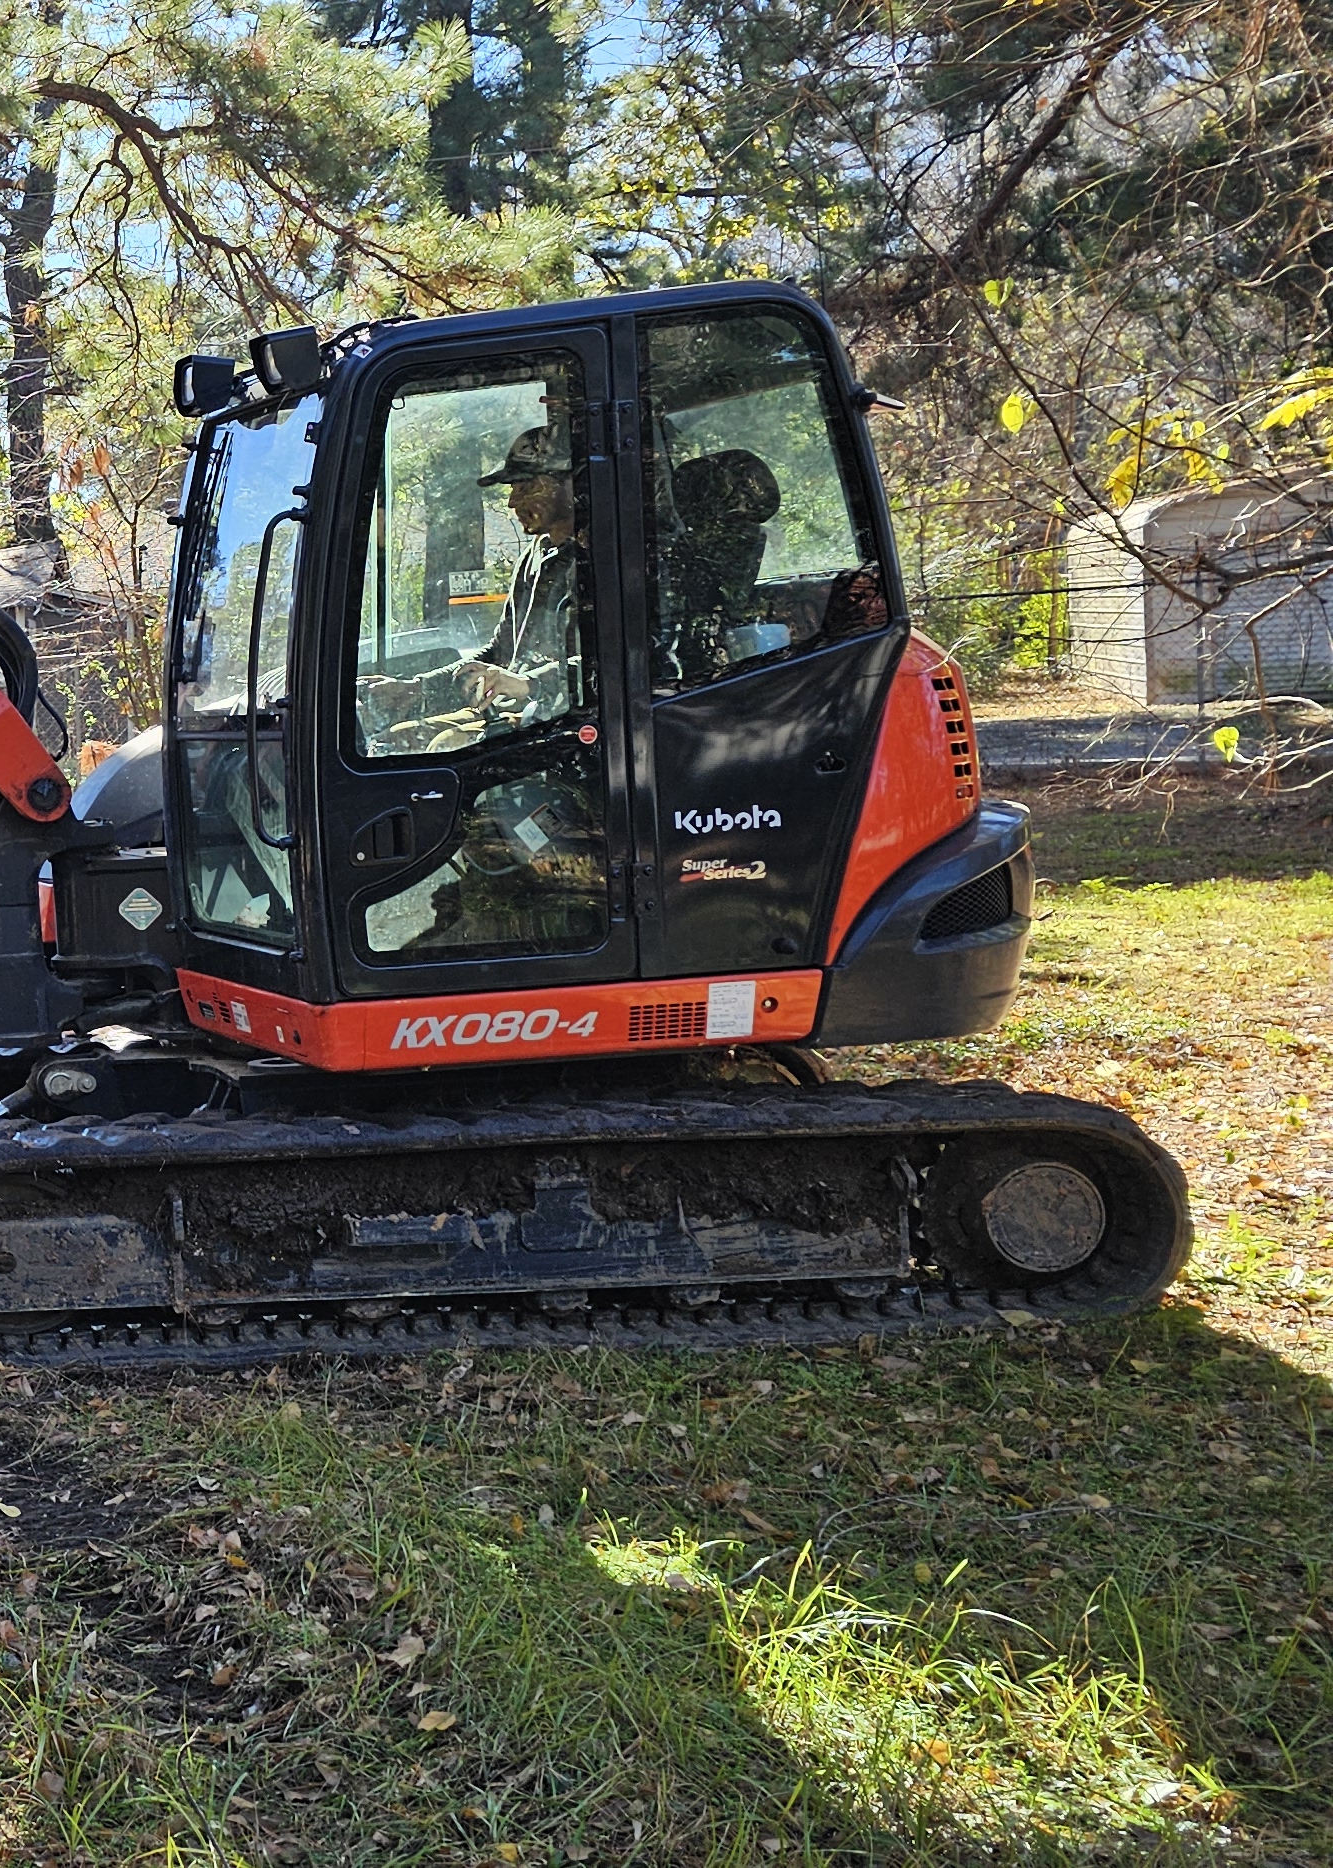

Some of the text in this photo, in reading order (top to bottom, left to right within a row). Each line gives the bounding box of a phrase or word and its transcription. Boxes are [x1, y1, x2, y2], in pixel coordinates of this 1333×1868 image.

[674, 804, 782, 834] Kubota
[681, 859, 728, 873] Super
[389, 1008, 599, 1050] KX080-4
